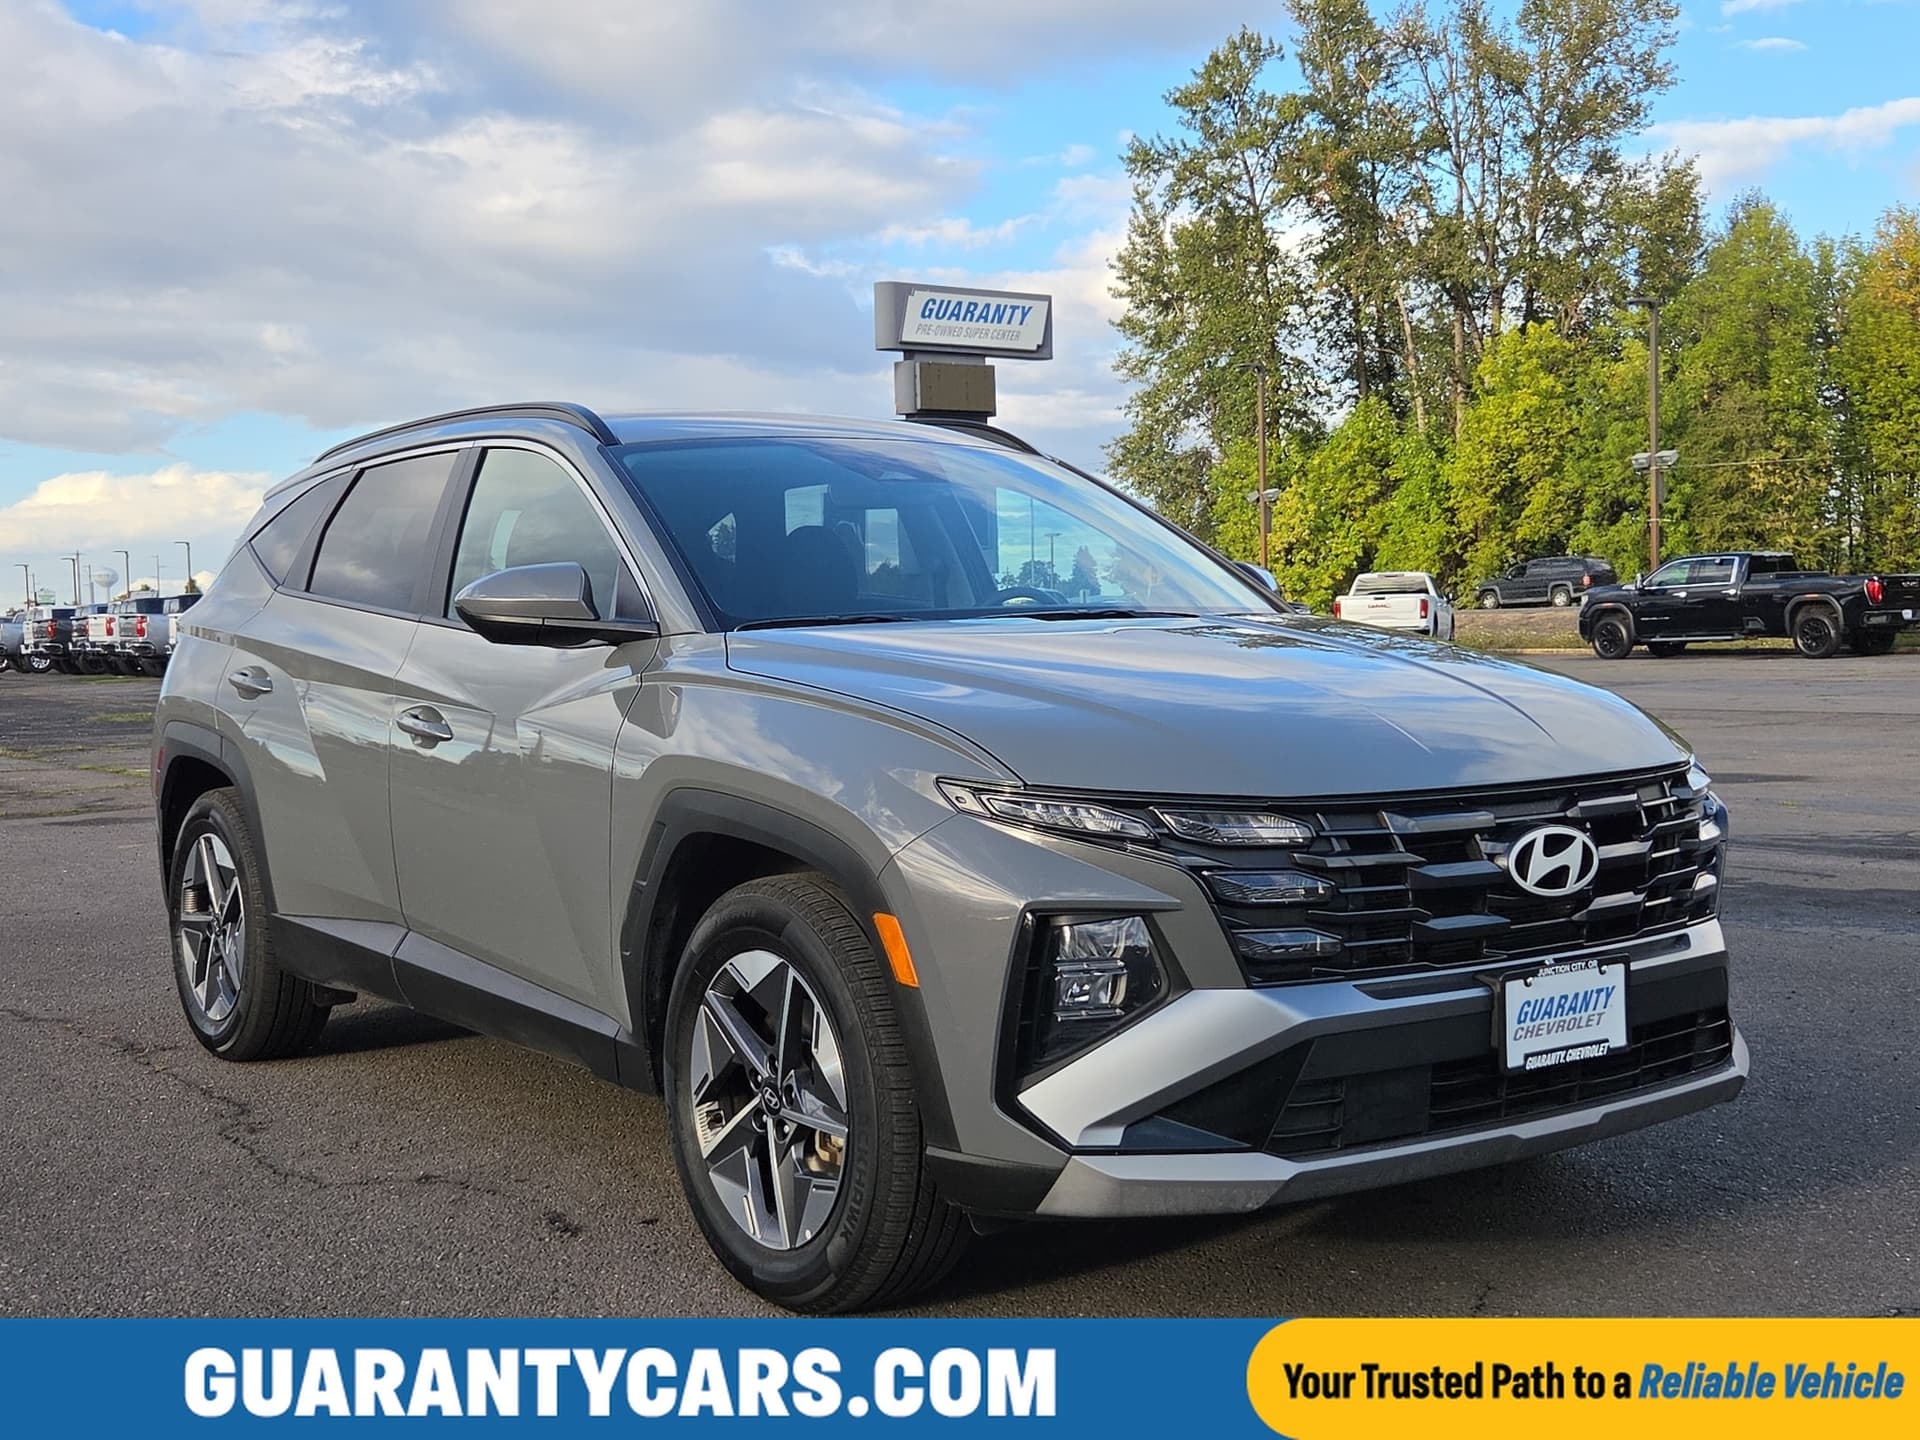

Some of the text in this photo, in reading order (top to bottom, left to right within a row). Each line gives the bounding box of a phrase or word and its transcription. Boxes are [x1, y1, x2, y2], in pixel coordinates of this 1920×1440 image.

[920, 298, 1033, 326] GUARANTY
[915, 323, 1021, 342] PRE-OWNED SUPER CENTER
[1517, 985, 1616, 1025] GUARANTY
[1513, 1012, 1605, 1041] CHEVROLET
[1566, 1042, 1610, 1063] CHEVROLET
